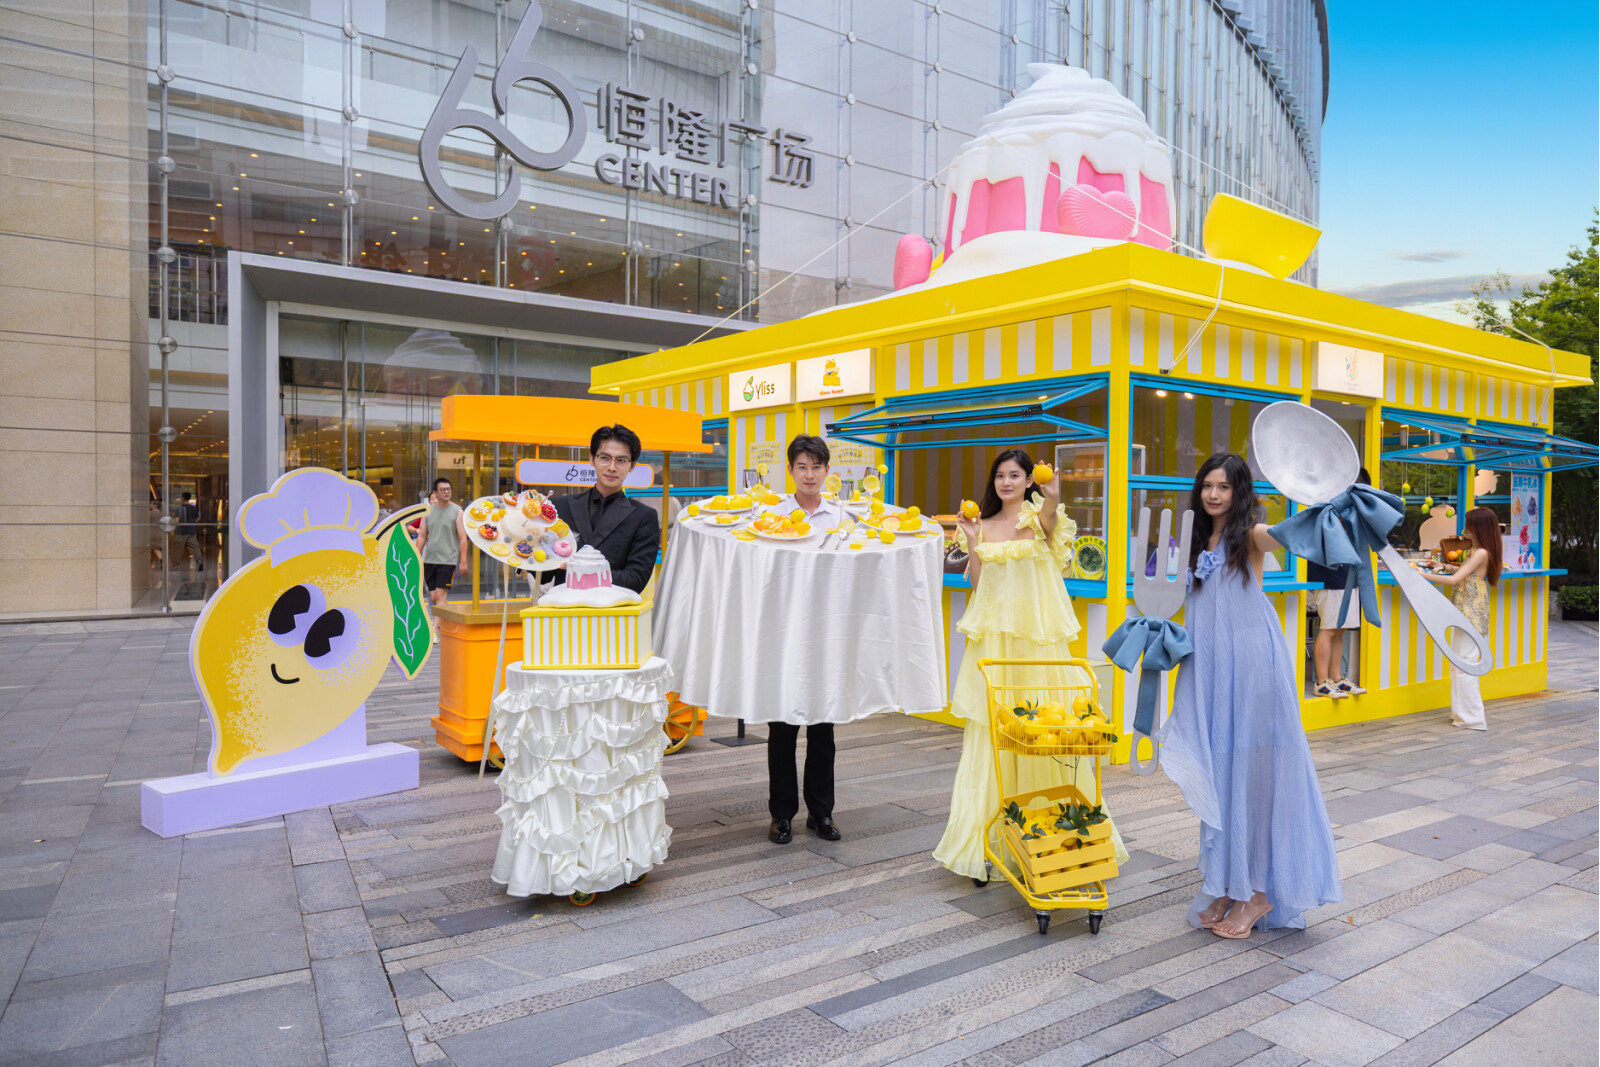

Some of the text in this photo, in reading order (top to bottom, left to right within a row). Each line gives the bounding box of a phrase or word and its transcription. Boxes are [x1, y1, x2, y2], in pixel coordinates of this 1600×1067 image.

[597, 82, 815, 188] 恒隆广场
[595, 152, 732, 209] CENTER
